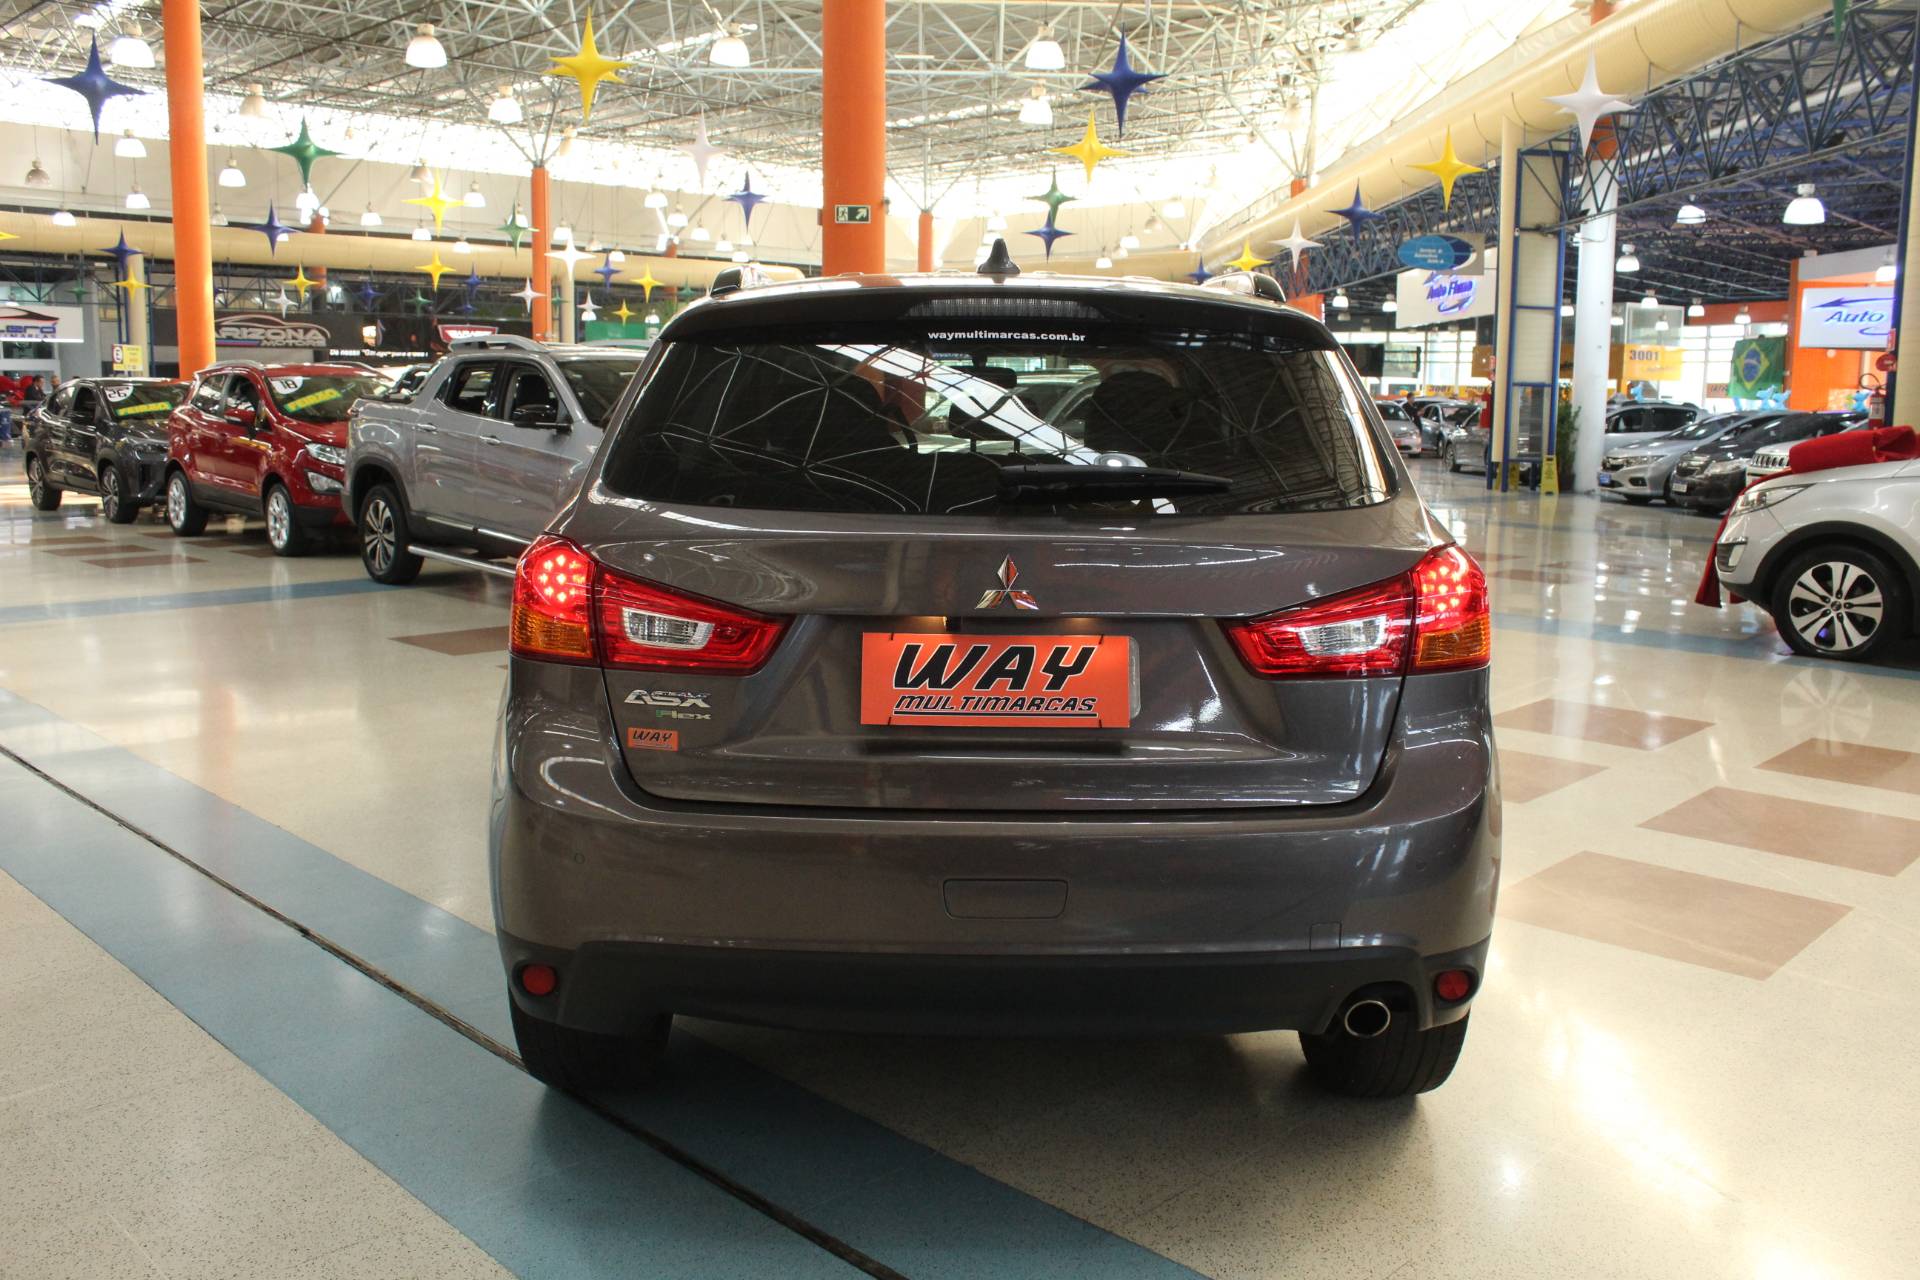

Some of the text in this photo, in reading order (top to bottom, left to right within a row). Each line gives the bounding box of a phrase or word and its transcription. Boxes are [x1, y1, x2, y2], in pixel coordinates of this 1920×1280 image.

[1825, 310, 1885, 323] Auto
[928, 330, 1086, 342] waymultimarcas.com.br
[1629, 349, 1660, 361] 3001
[893, 643, 1097, 692] WAY
[624, 689, 711, 708] ASX
[893, 694, 1098, 712] MULTIMARCAS
[655, 710, 711, 720] Flex
[632, 730, 673, 742] WAY
